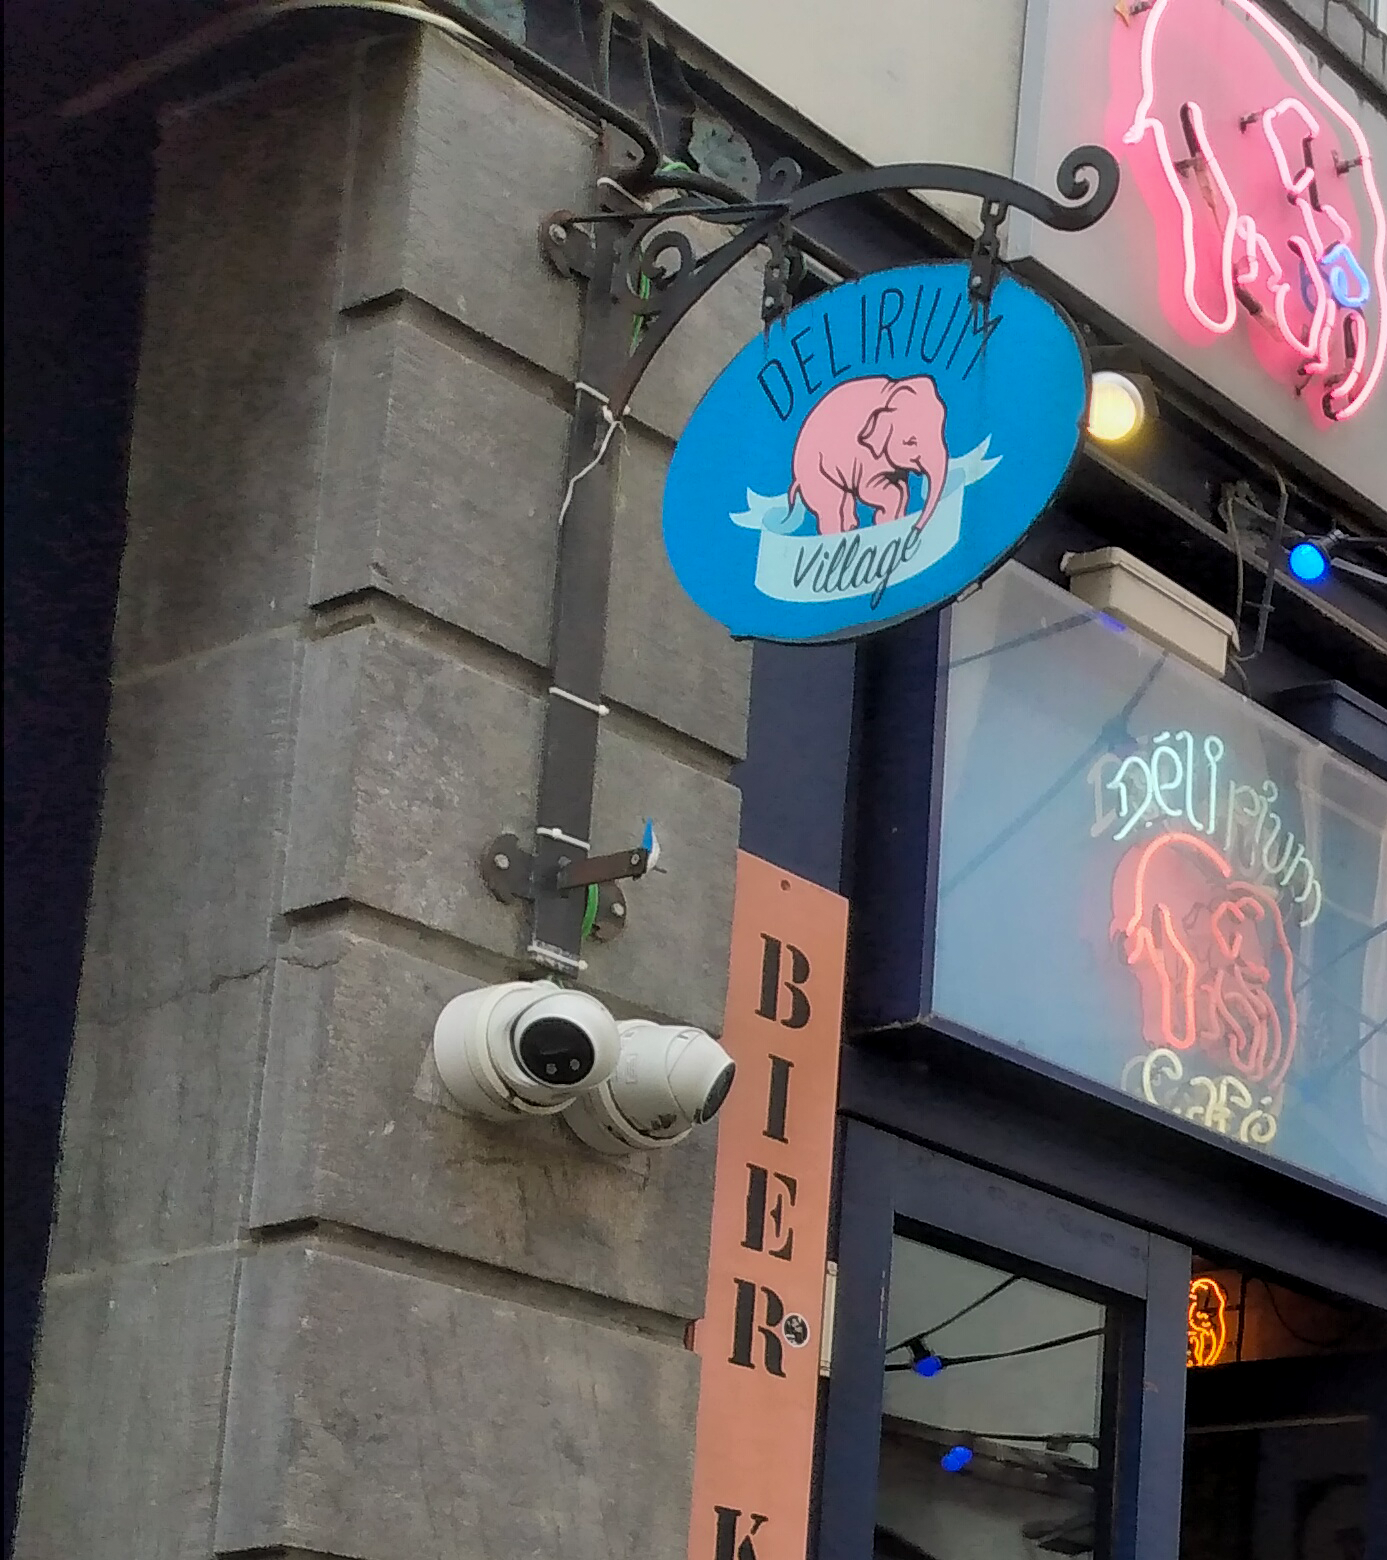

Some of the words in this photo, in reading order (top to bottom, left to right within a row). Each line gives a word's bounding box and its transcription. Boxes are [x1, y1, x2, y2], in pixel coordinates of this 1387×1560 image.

[756, 284, 1004, 421] DELIRIUM
[793, 526, 924, 611] Village
[727, 932, 812, 1378] BIER
